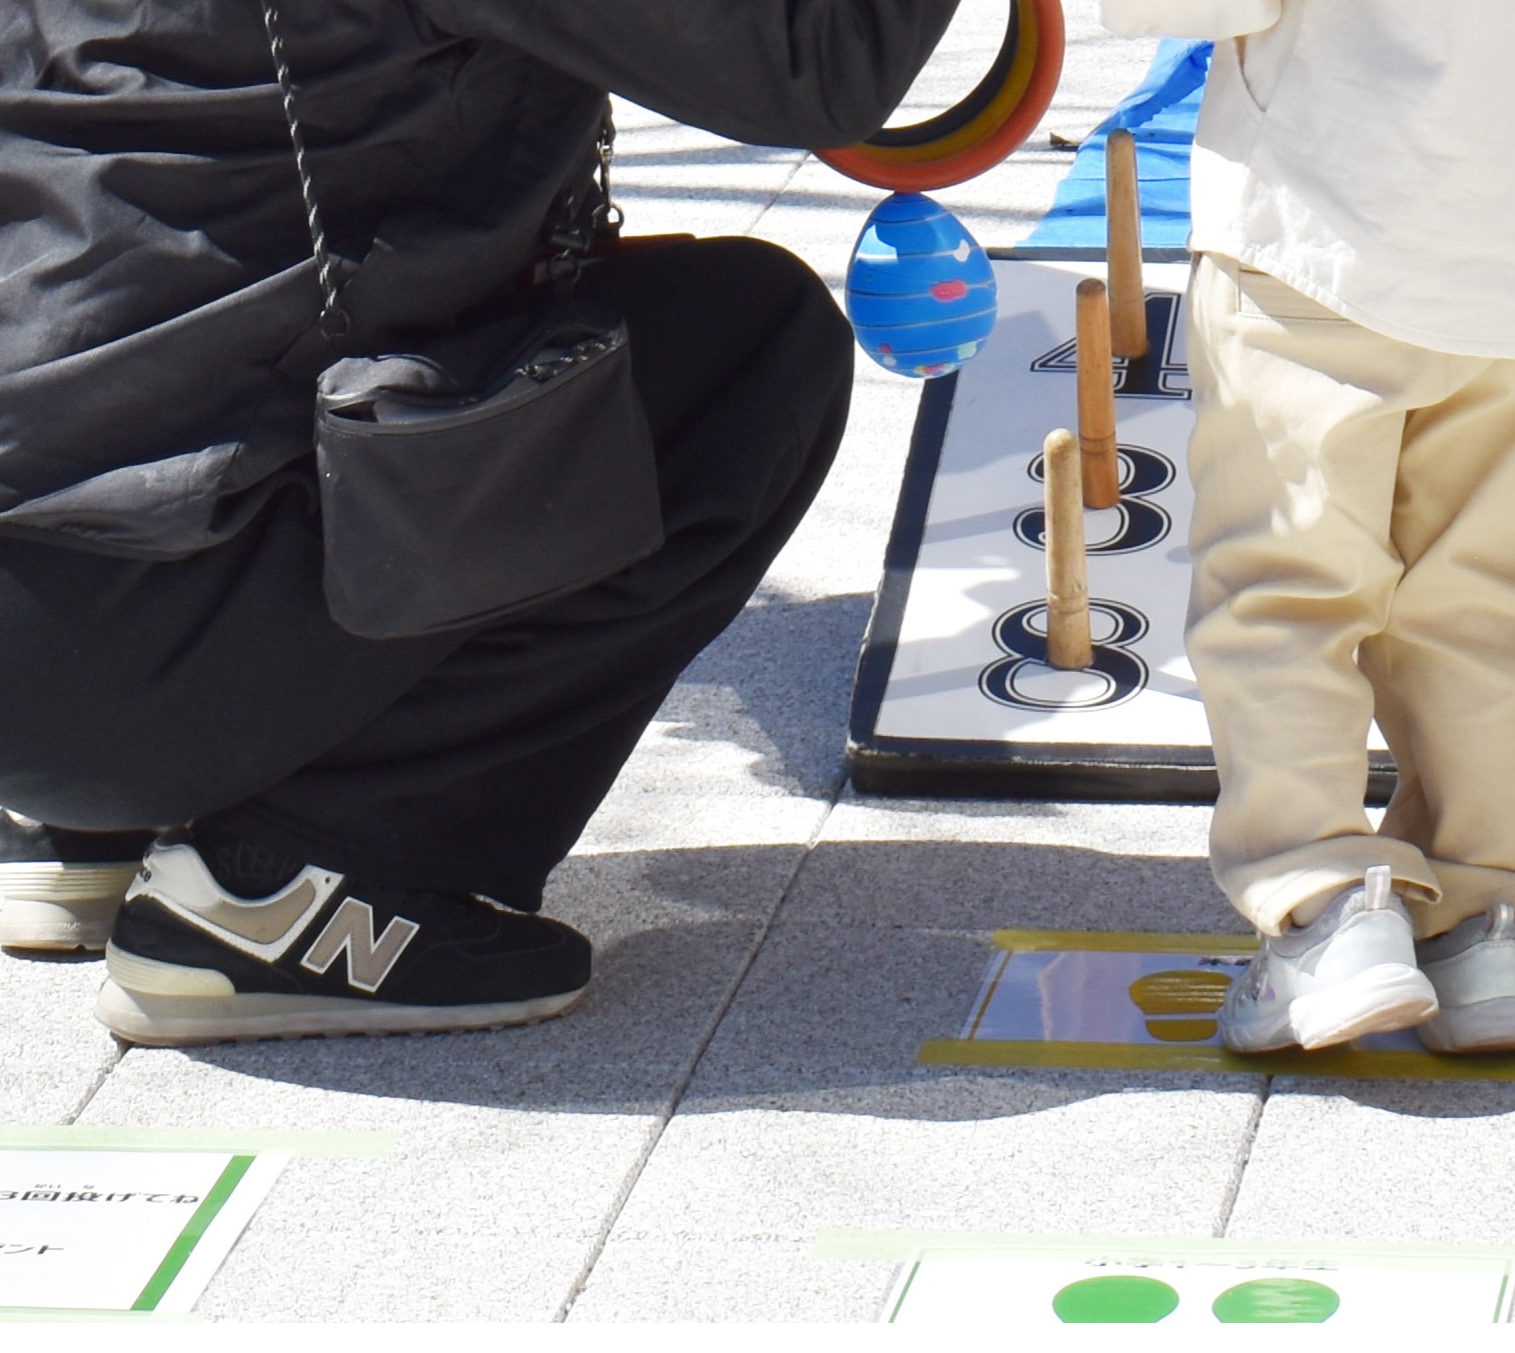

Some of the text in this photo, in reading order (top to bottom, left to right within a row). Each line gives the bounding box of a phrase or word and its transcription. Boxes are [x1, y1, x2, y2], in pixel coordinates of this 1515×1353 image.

[1014, 444, 1176, 555] 3
[978, 597, 1149, 712] 8
[298, 896, 420, 993] N
